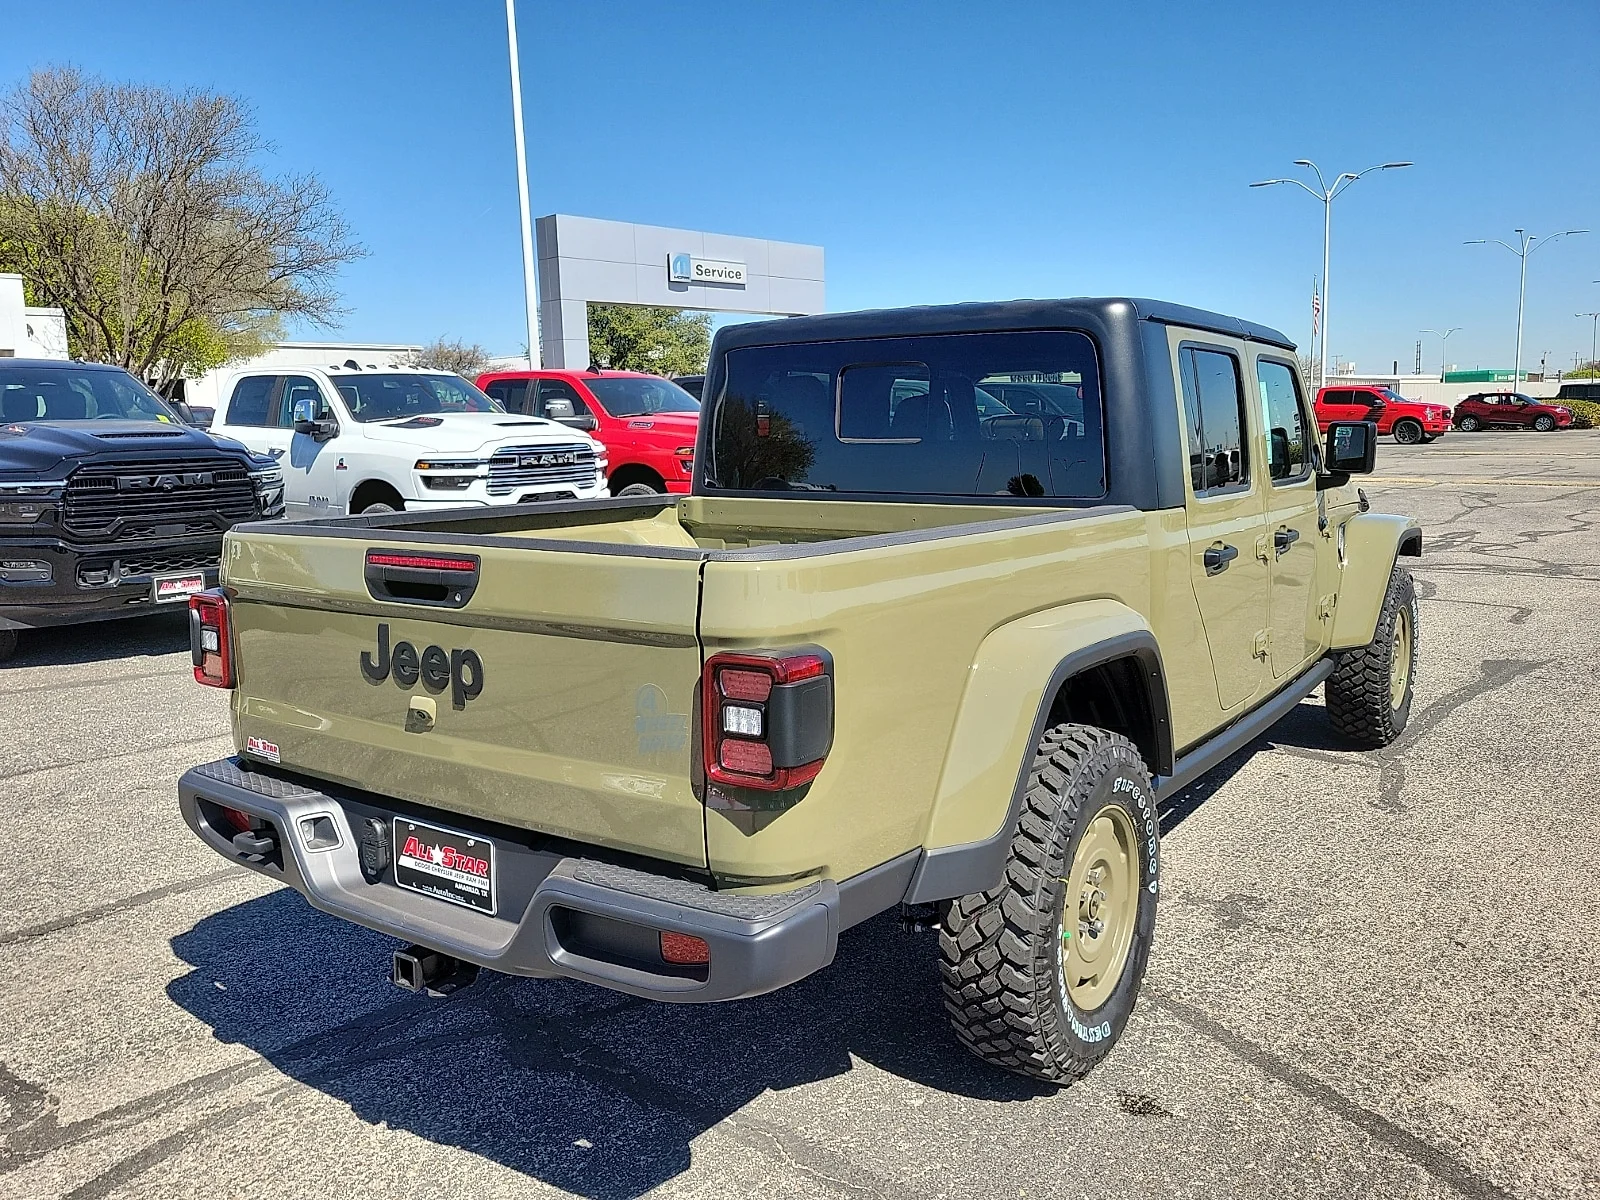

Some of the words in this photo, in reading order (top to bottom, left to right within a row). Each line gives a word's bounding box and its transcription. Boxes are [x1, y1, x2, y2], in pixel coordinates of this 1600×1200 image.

[695, 264, 742, 279] Service
[521, 453, 574, 466] RAM
[118, 473, 214, 489] RAM
[360, 623, 483, 709] Jeep
[248, 738, 260, 749] ALL
[1112, 776, 1158, 875] Firestone
[403, 836, 434, 862] ALL
[440, 846, 488, 877] STAR
[414, 861, 431, 871] DODGE
[431, 866, 453, 877] CHRYSLER
[465, 875, 477, 884] RAM
[480, 888, 489, 898] TX
